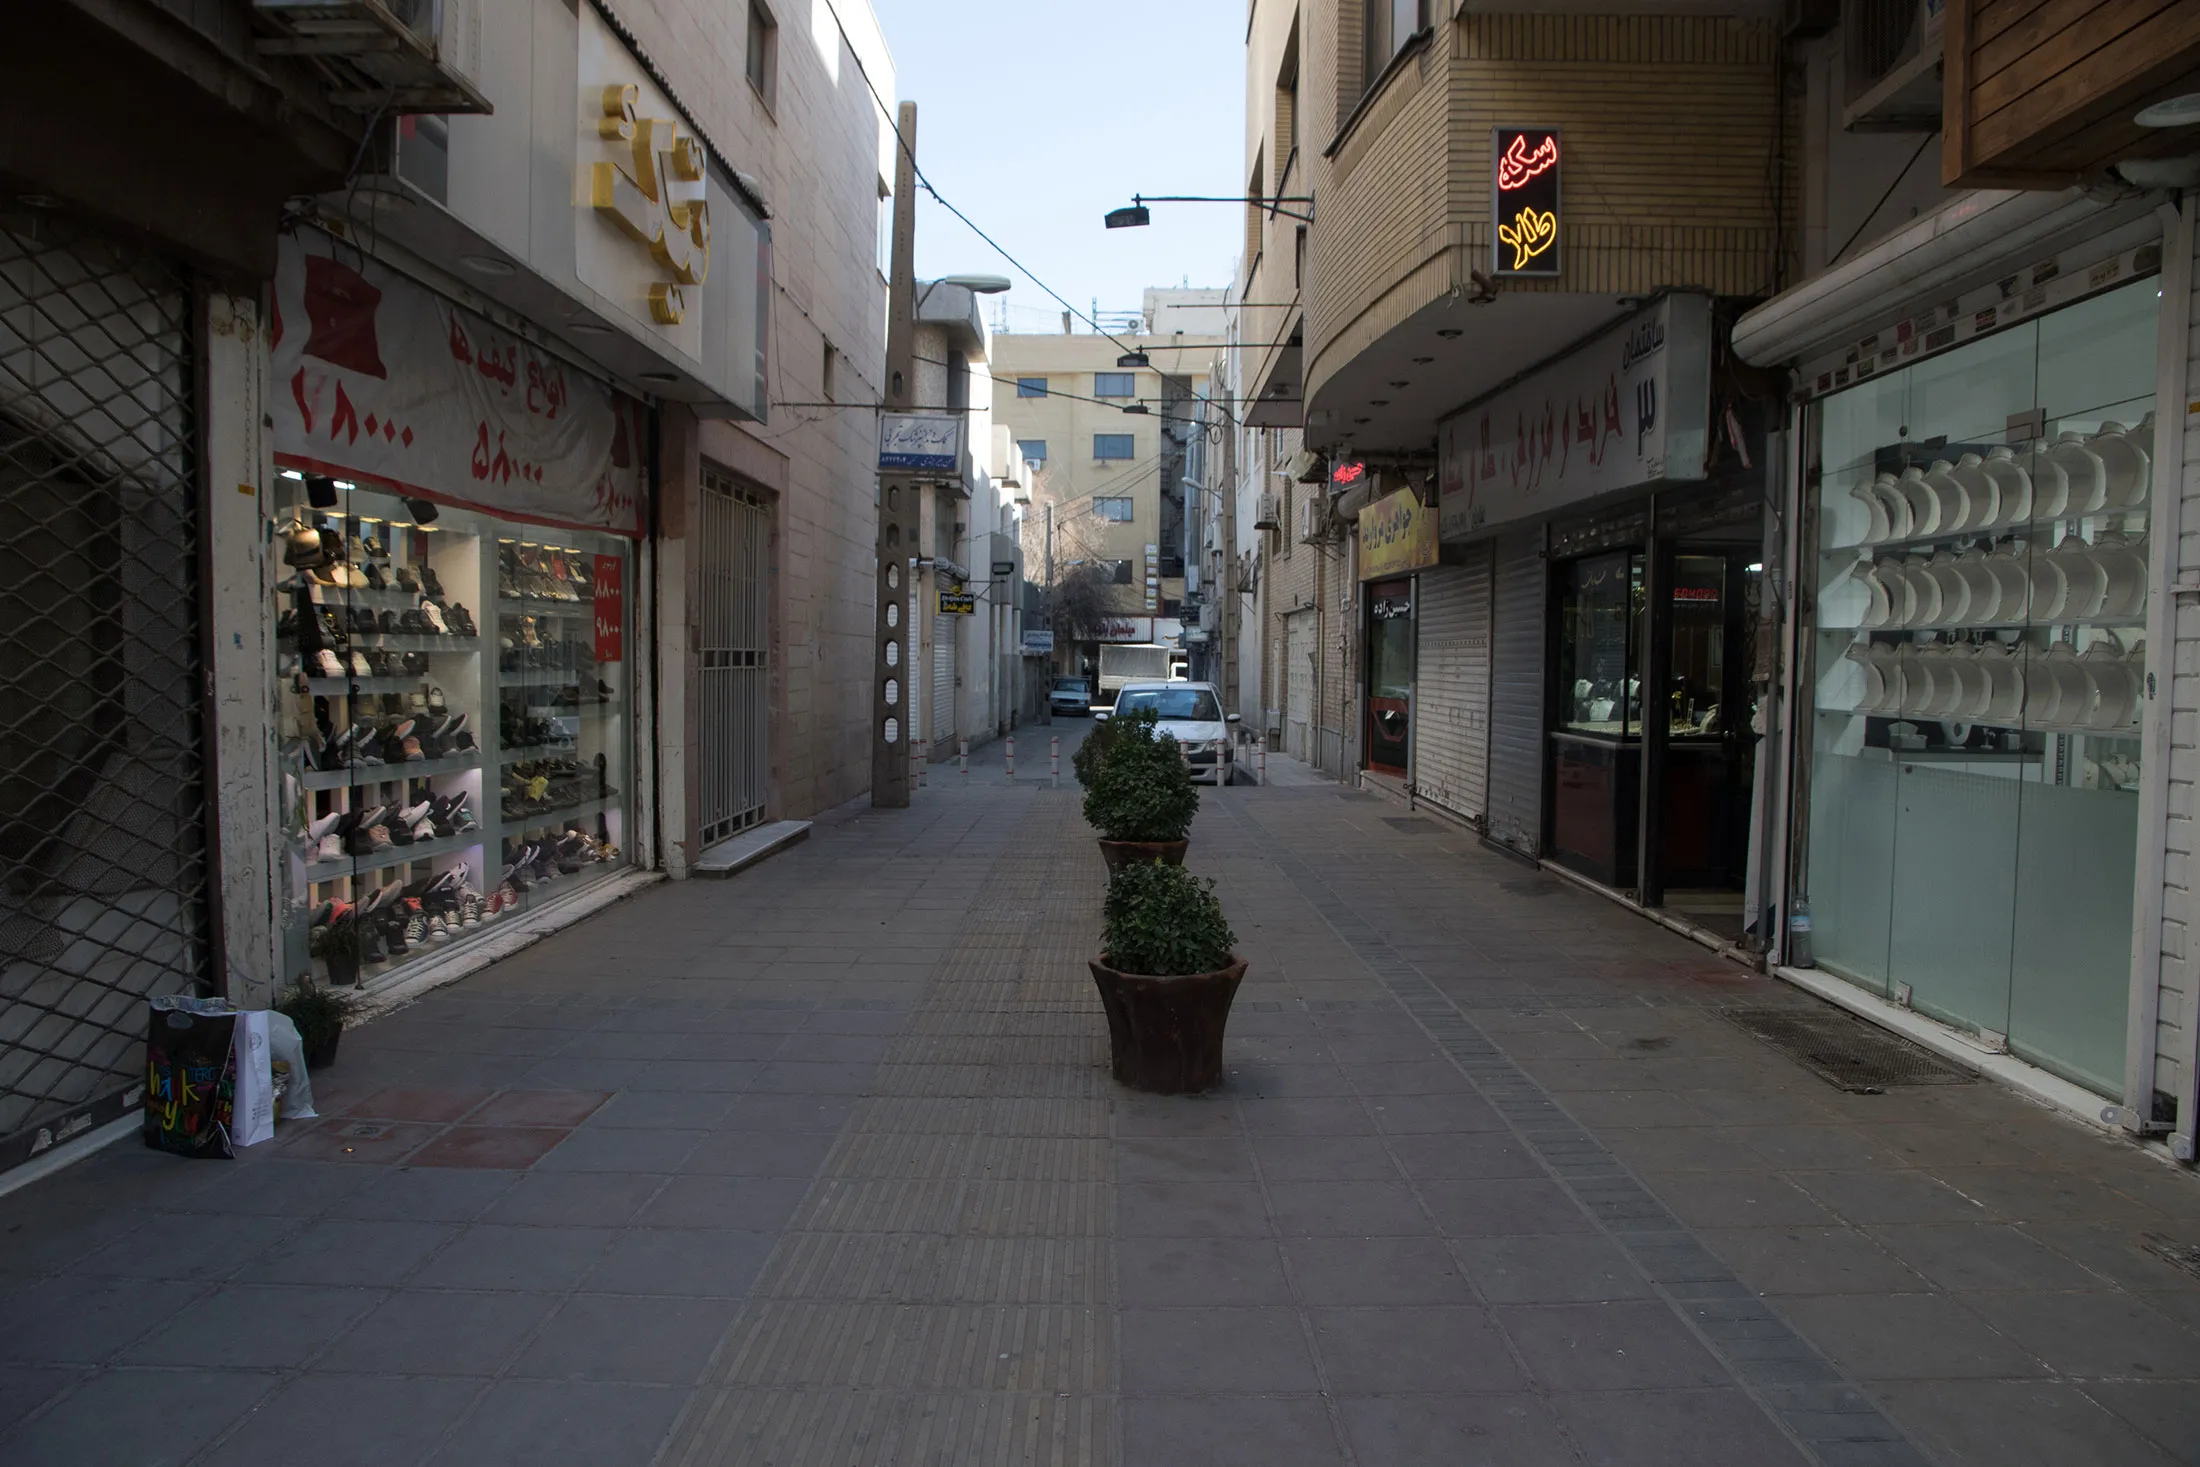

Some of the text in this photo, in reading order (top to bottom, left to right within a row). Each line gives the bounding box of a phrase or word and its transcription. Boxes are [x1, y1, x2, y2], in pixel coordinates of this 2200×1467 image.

[1499, 134, 1558, 190] سکه
[1498, 206, 1556, 271] طلا
[477, 333, 517, 397] کیف
[1622, 316, 1665, 373] ساختمان
[1577, 371, 1623, 467] خرید
